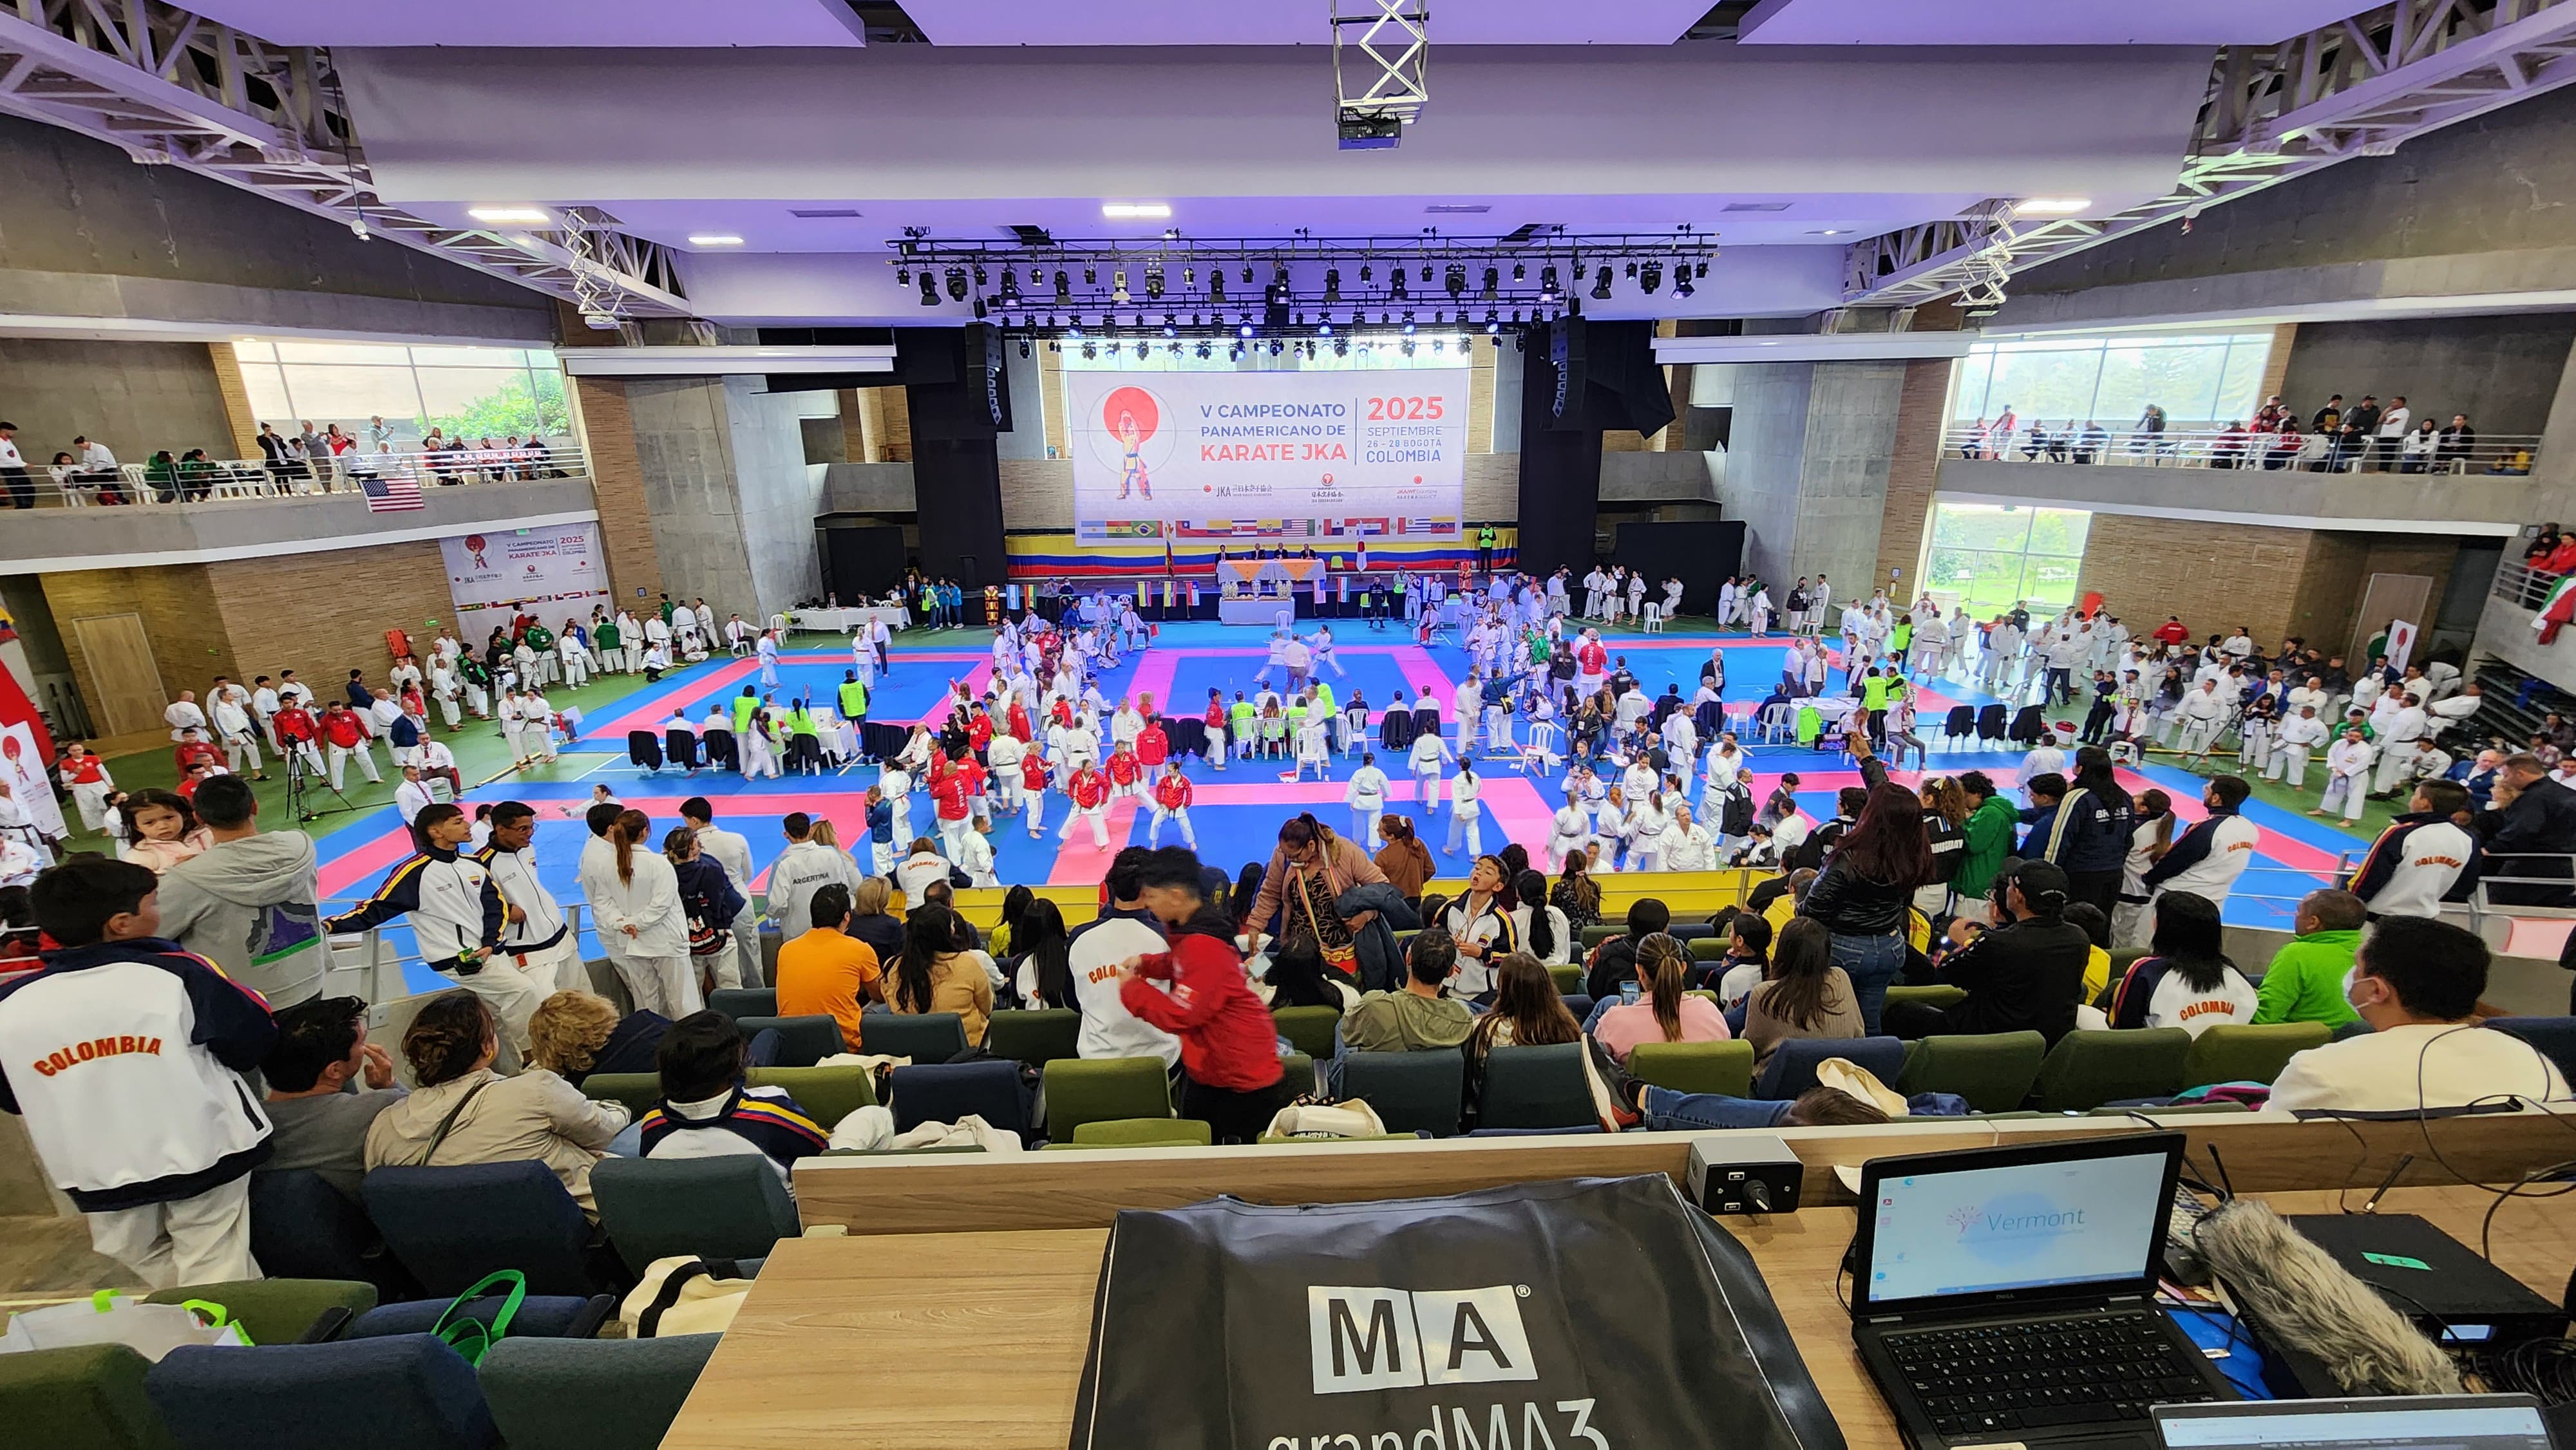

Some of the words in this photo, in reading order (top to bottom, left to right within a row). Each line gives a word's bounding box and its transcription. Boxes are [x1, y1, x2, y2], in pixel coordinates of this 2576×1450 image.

[1200, 404, 1213, 418] V
[1217, 403, 1346, 418] CAMPEONATO
[1367, 396, 1443, 420] 2025
[1200, 425, 1322, 437] PANAMERICANO
[1326, 424, 1346, 436] DE
[1367, 426, 1443, 437] SEPTIEMBRE
[1367, 440, 1378, 448] 26
[1388, 439, 1400, 447] 28
[1200, 443, 1294, 462] KARATE
[1301, 443, 1348, 460] JKA
[1366, 449, 1441, 463] COLOMBIA
[1216, 486, 1231, 497] JKA
[512, 539, 554, 547] CAMPEONATO
[560, 535, 584, 544] 2025
[2095, 807, 2129, 819] BRSIL
[792, 872, 830, 885] ARGENTINA
[2179, 1000, 2235, 1021] COLOMBIA
[33, 1035, 162, 1077] COLOMBIA
[1987, 1208, 2086, 1232] Vermont
